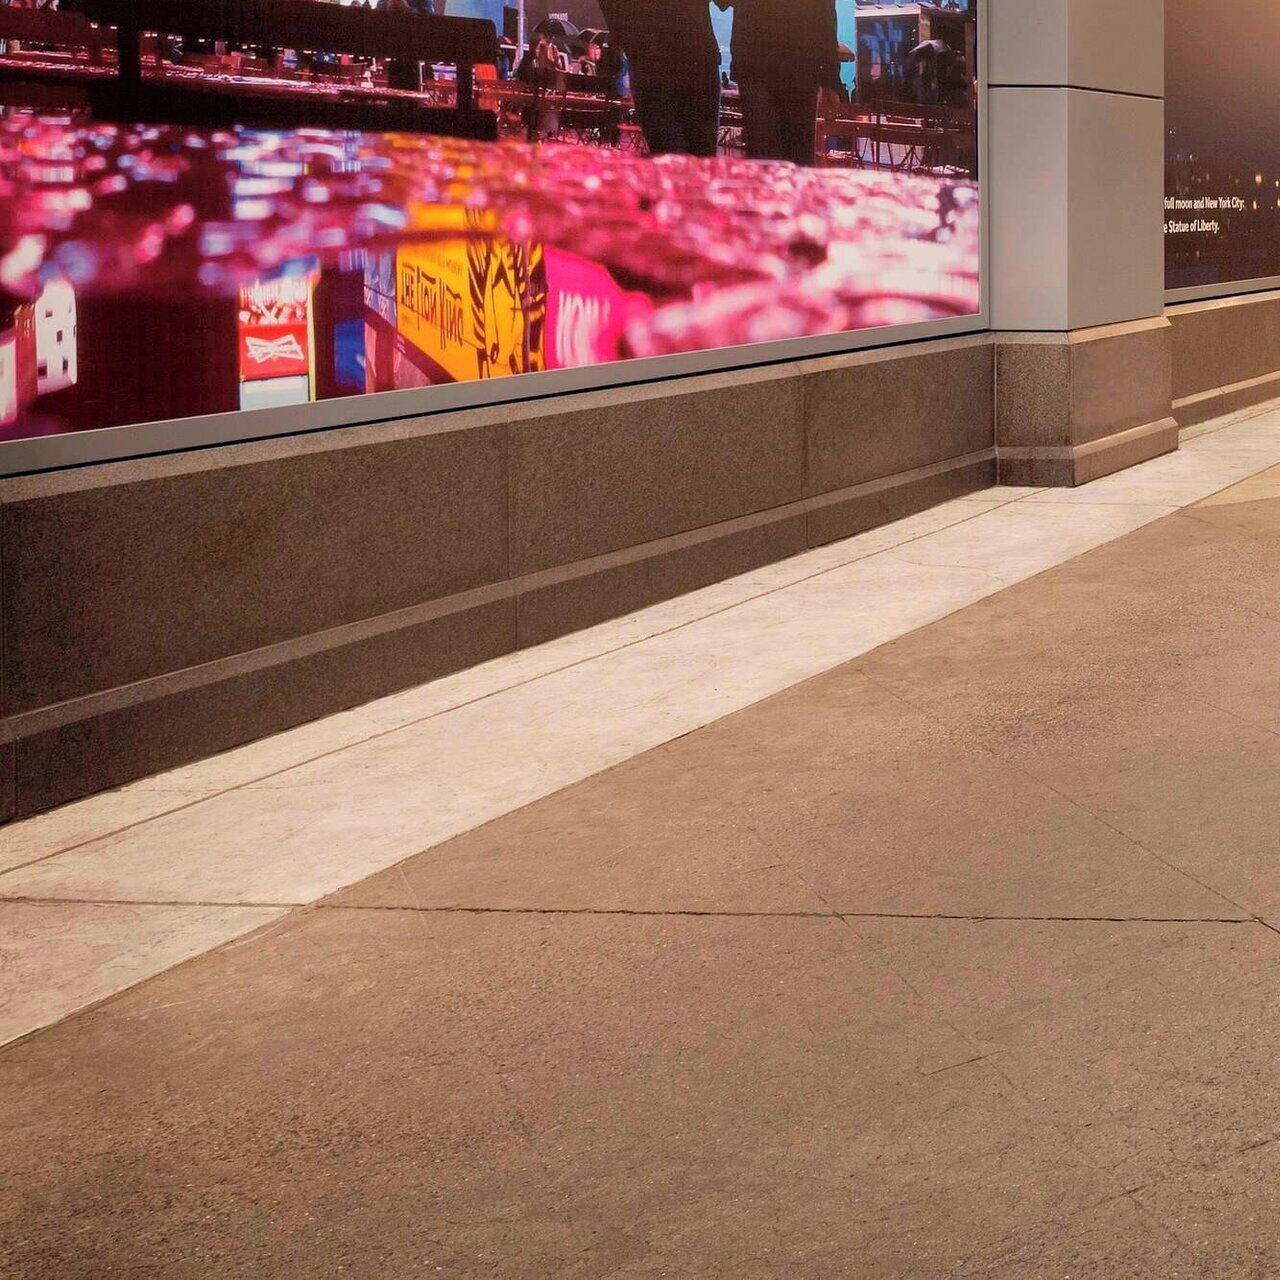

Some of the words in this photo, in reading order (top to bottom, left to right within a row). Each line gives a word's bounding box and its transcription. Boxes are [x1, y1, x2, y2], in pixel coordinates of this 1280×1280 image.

[1175, 200, 1193, 209] moon
[1194, 197, 1204, 209] and
[1205, 197, 1218, 209] New
[1218, 196, 1231, 209] York
[1168, 221, 1189, 233] Statue
[1190, 220, 1197, 231] of
[1197, 220, 1220, 234] Liberty.
